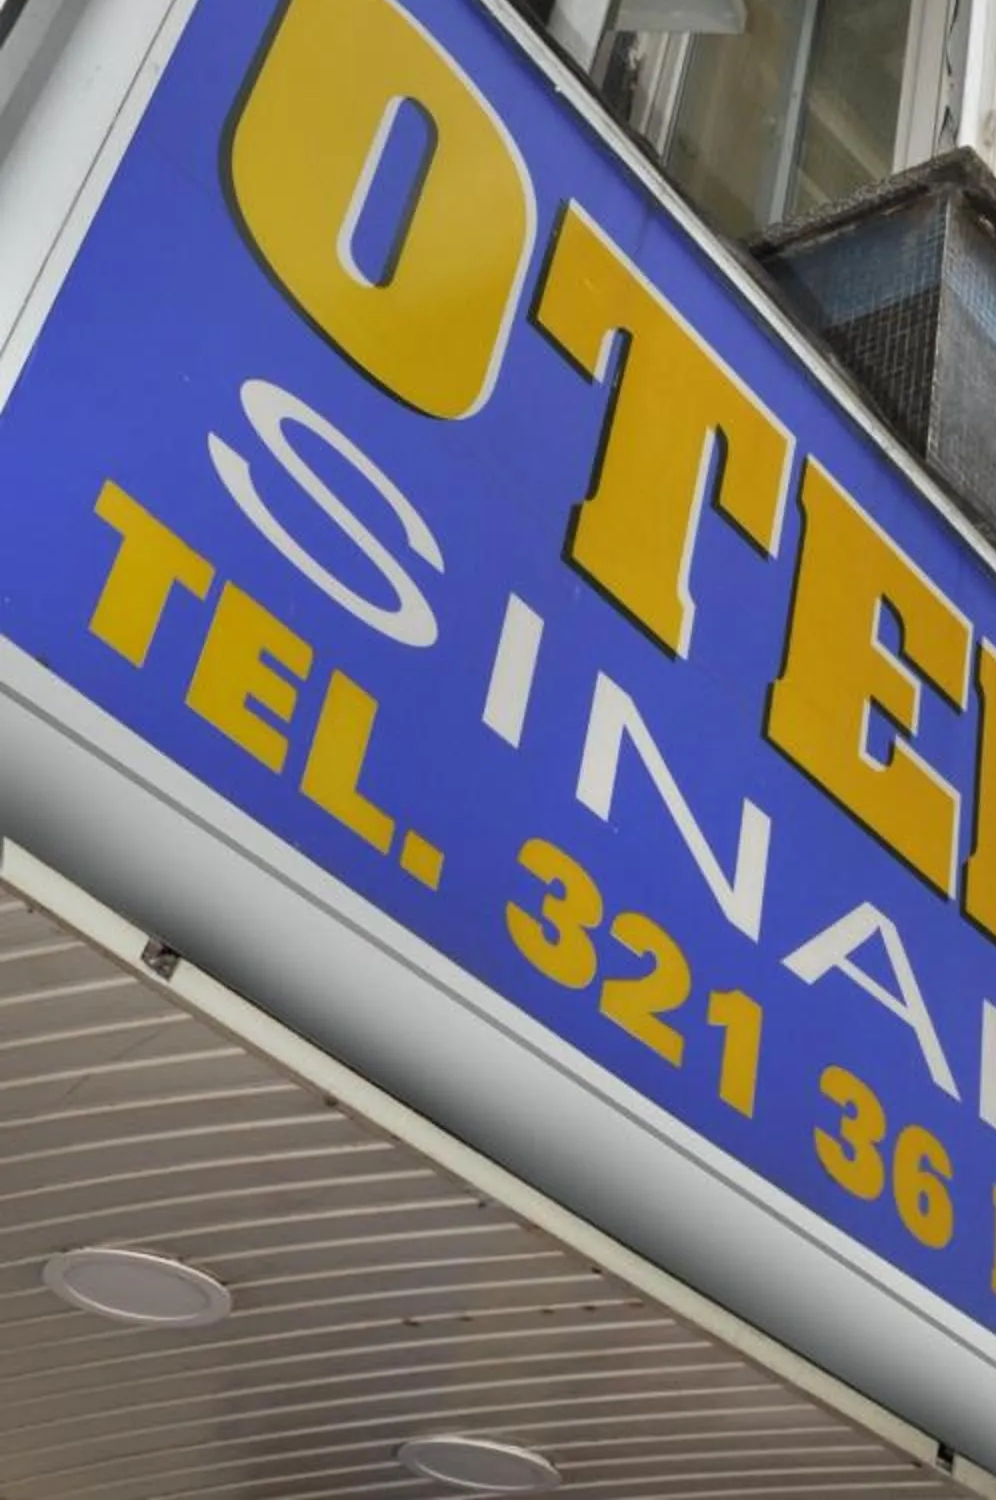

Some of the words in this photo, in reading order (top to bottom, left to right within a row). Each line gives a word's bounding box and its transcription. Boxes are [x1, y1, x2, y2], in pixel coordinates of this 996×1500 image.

[92, 480, 444, 888] TEL.
[506, 838, 763, 1118] 321
[813, 1064, 955, 1249] 36
